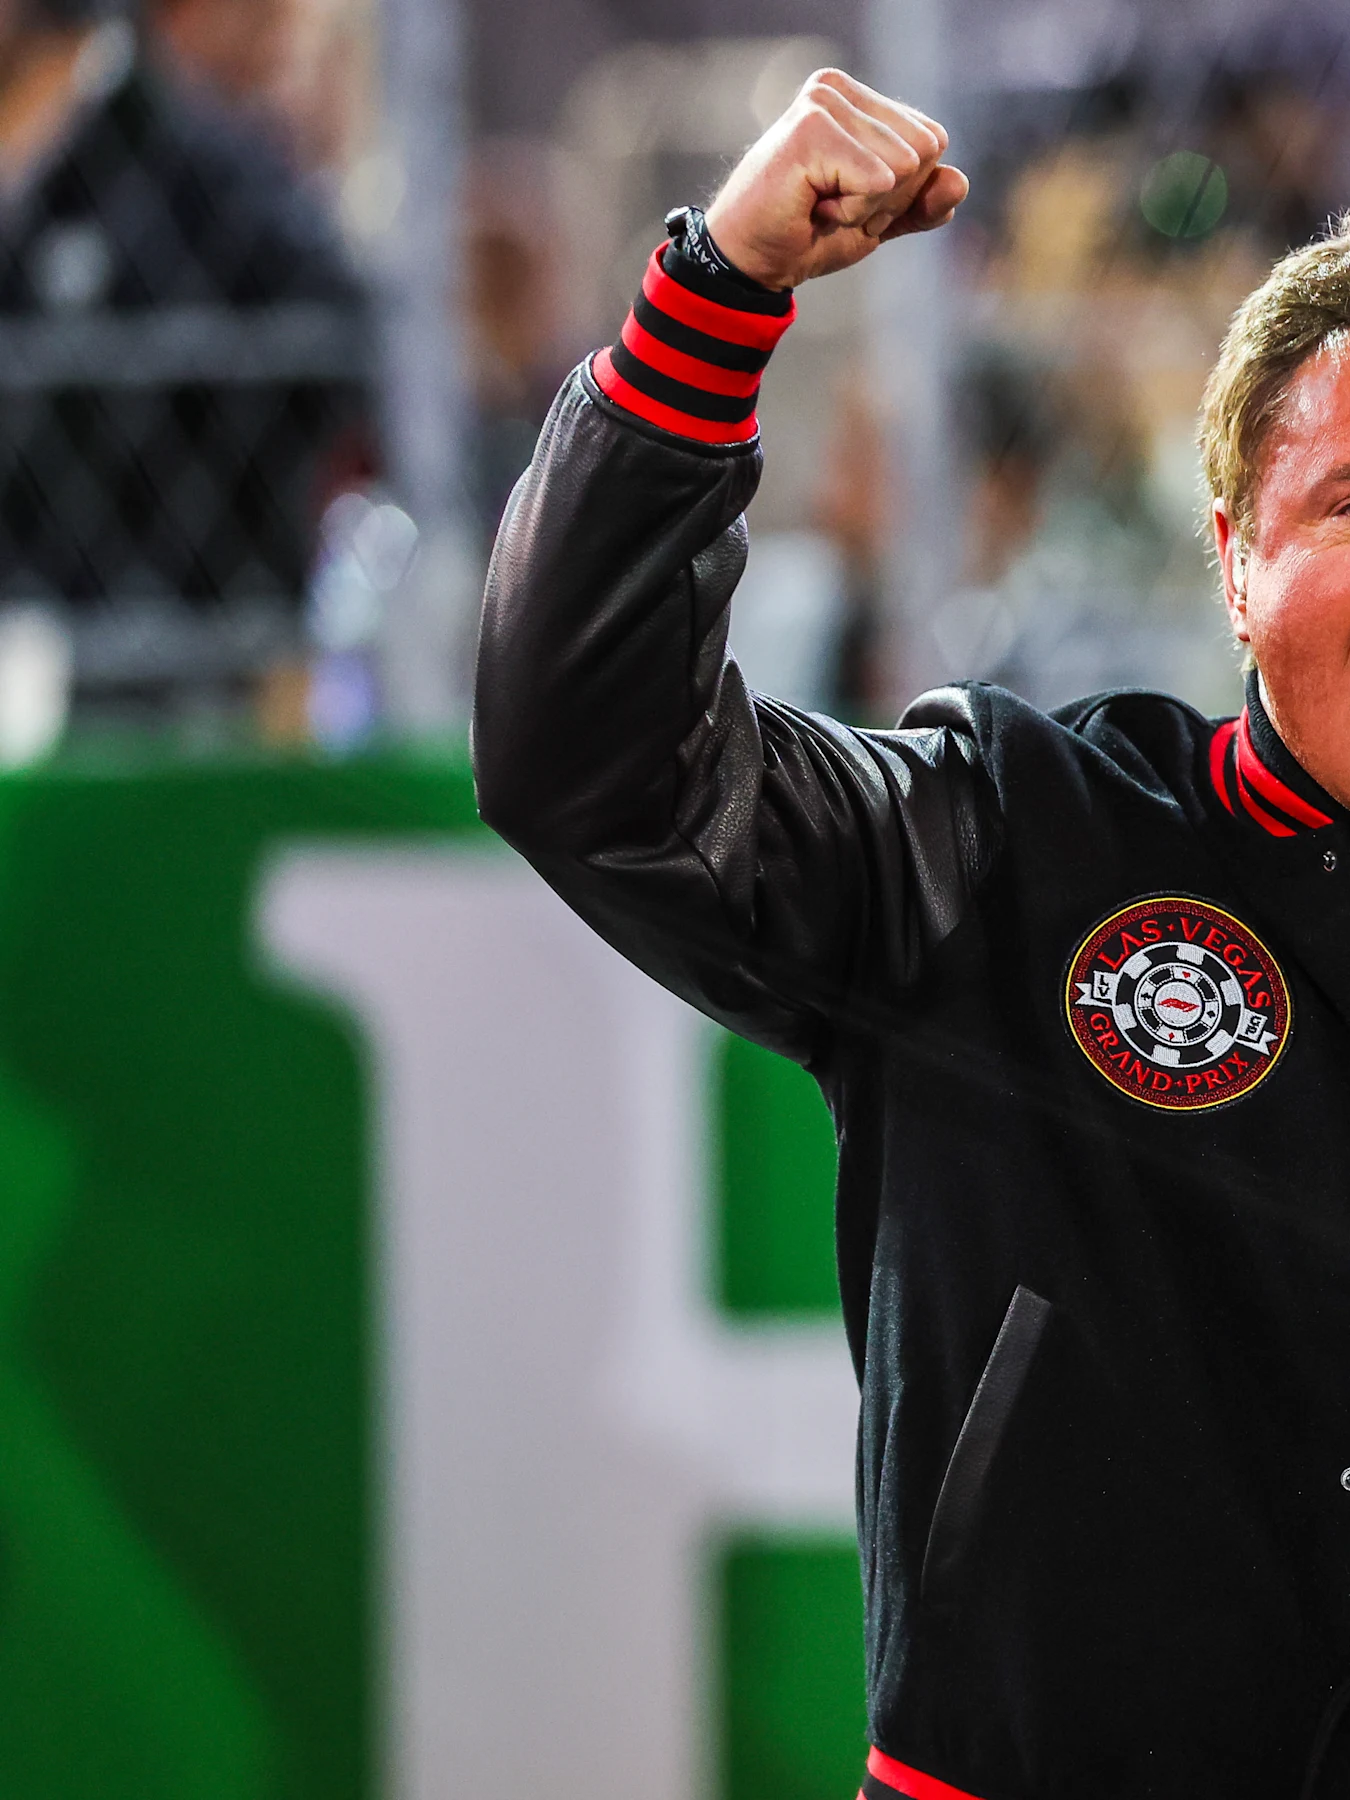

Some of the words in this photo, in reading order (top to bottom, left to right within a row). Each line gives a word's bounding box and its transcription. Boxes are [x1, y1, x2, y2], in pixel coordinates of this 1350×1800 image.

[1097, 919, 1163, 971] LAS
[1179, 917, 1273, 1009] VEGAS
[1090, 1012, 1172, 1092] GRAND
[1185, 1050, 1250, 1094] PRIX
